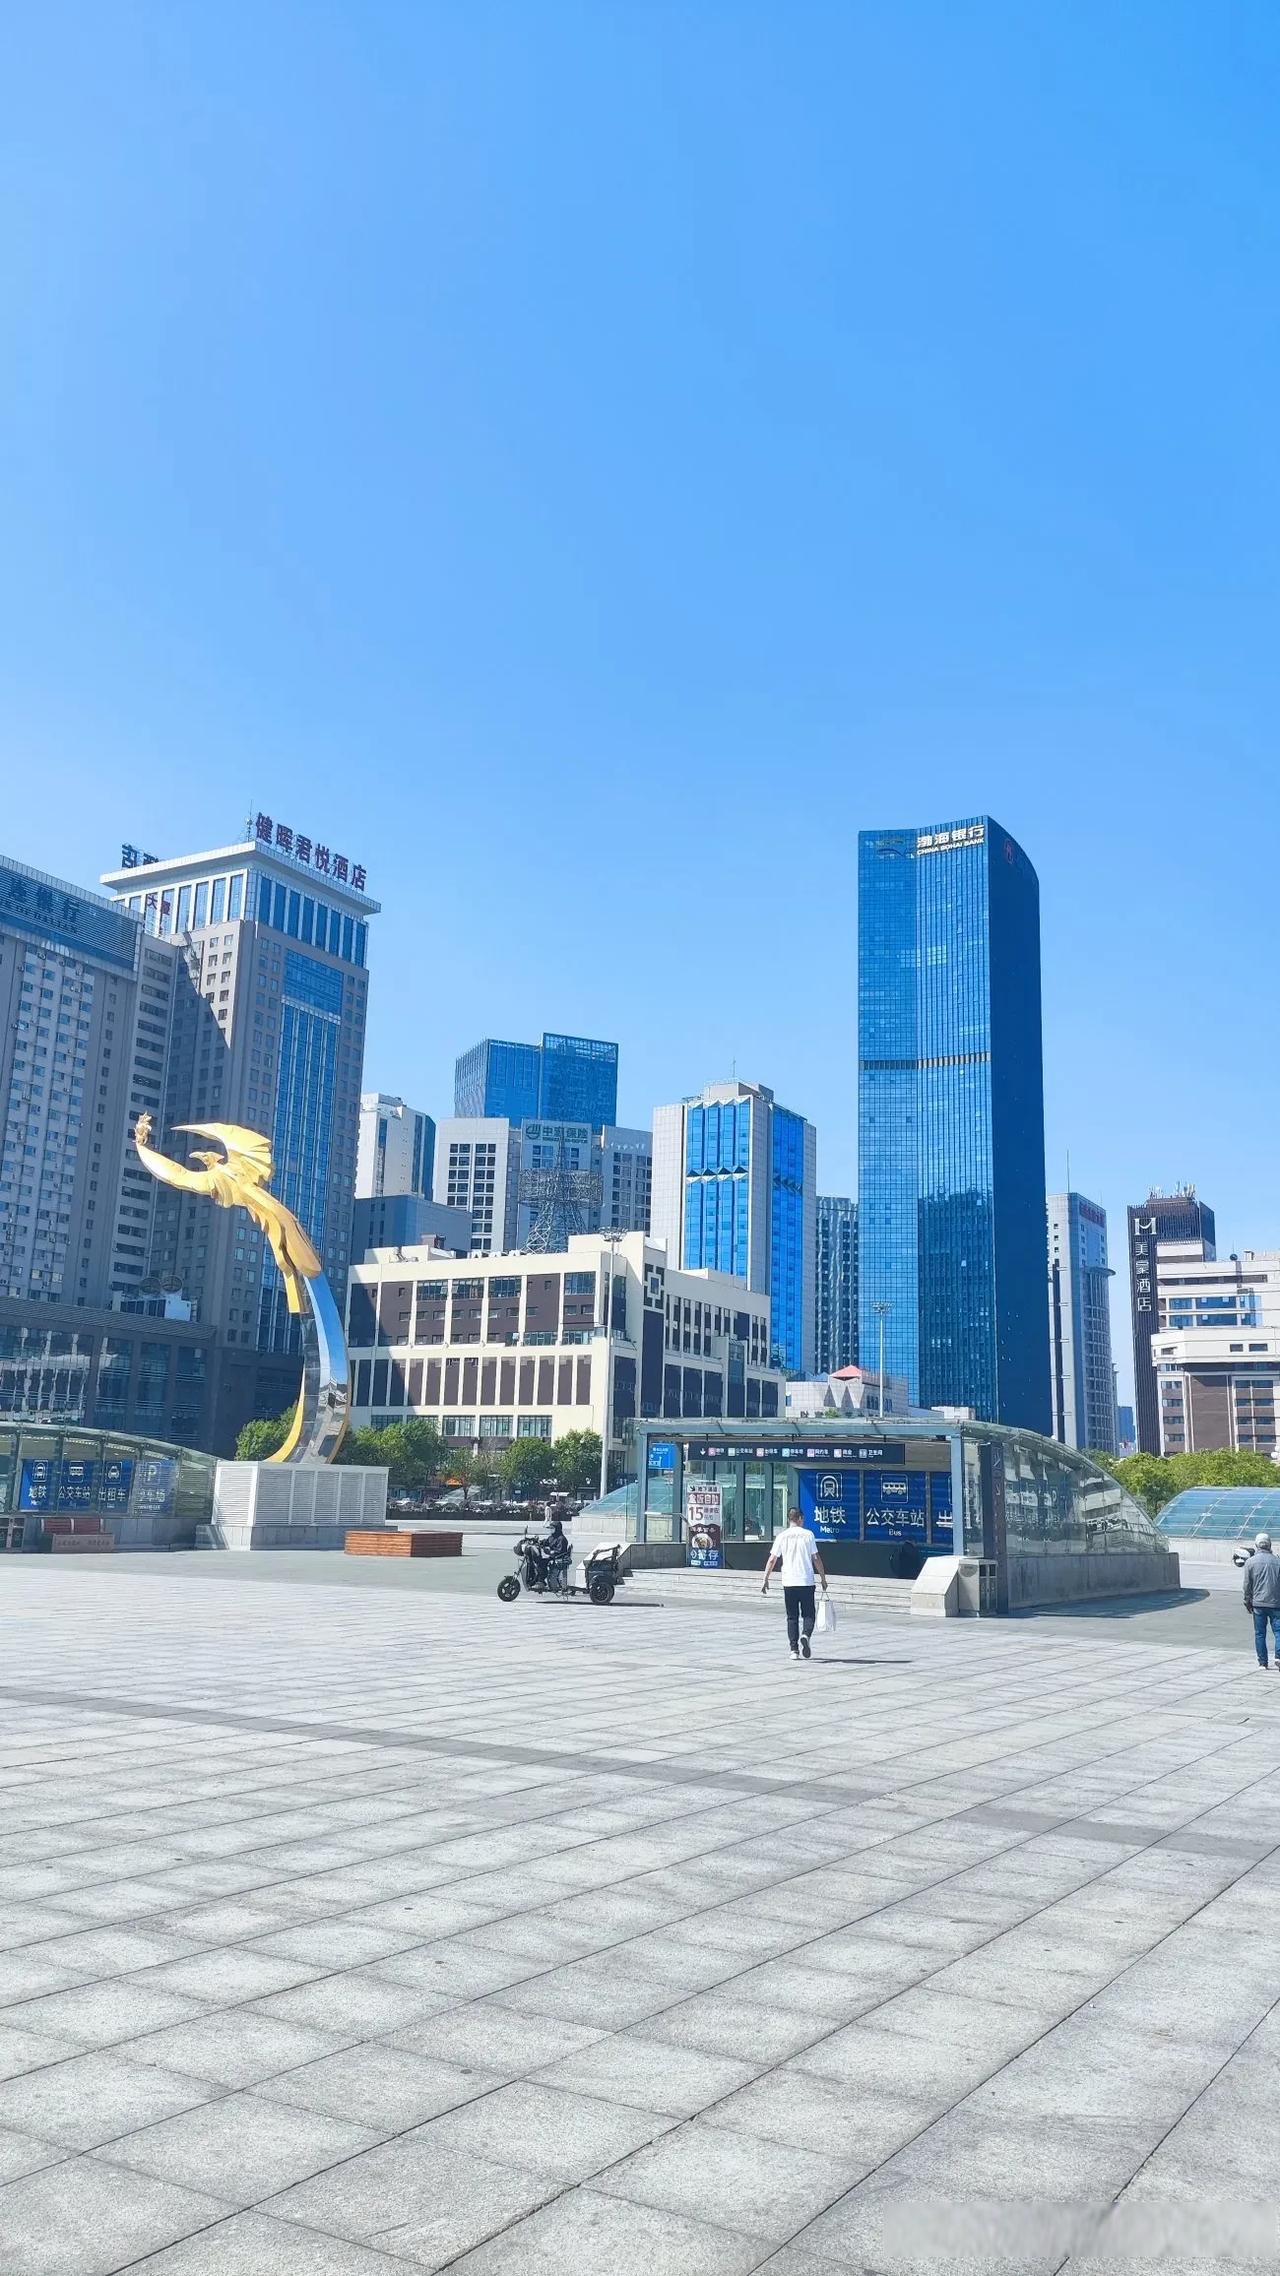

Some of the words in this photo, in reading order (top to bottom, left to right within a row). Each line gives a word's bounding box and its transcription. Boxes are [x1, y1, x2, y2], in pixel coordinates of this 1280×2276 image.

[917, 824, 985, 848] 渤海银行
[256, 811, 368, 892] 健晖君悦酒店
[917, 846, 939, 856] CHINA
[941, 842, 963, 852] BOHAI
[964, 837, 985, 848] BANK
[1135, 1241, 1152, 1312] 美豪酒店
[28, 1485, 48, 1499] 地铁
[58, 1485, 92, 1500] 公交车站
[98, 1486, 127, 1502] 出租车
[689, 1506, 704, 1521] 15
[813, 1505, 846, 1525] 地铁
[866, 1506, 925, 1528] 公交车站
[819, 1525, 840, 1534] Metro
[888, 1528, 902, 1537] Bus
